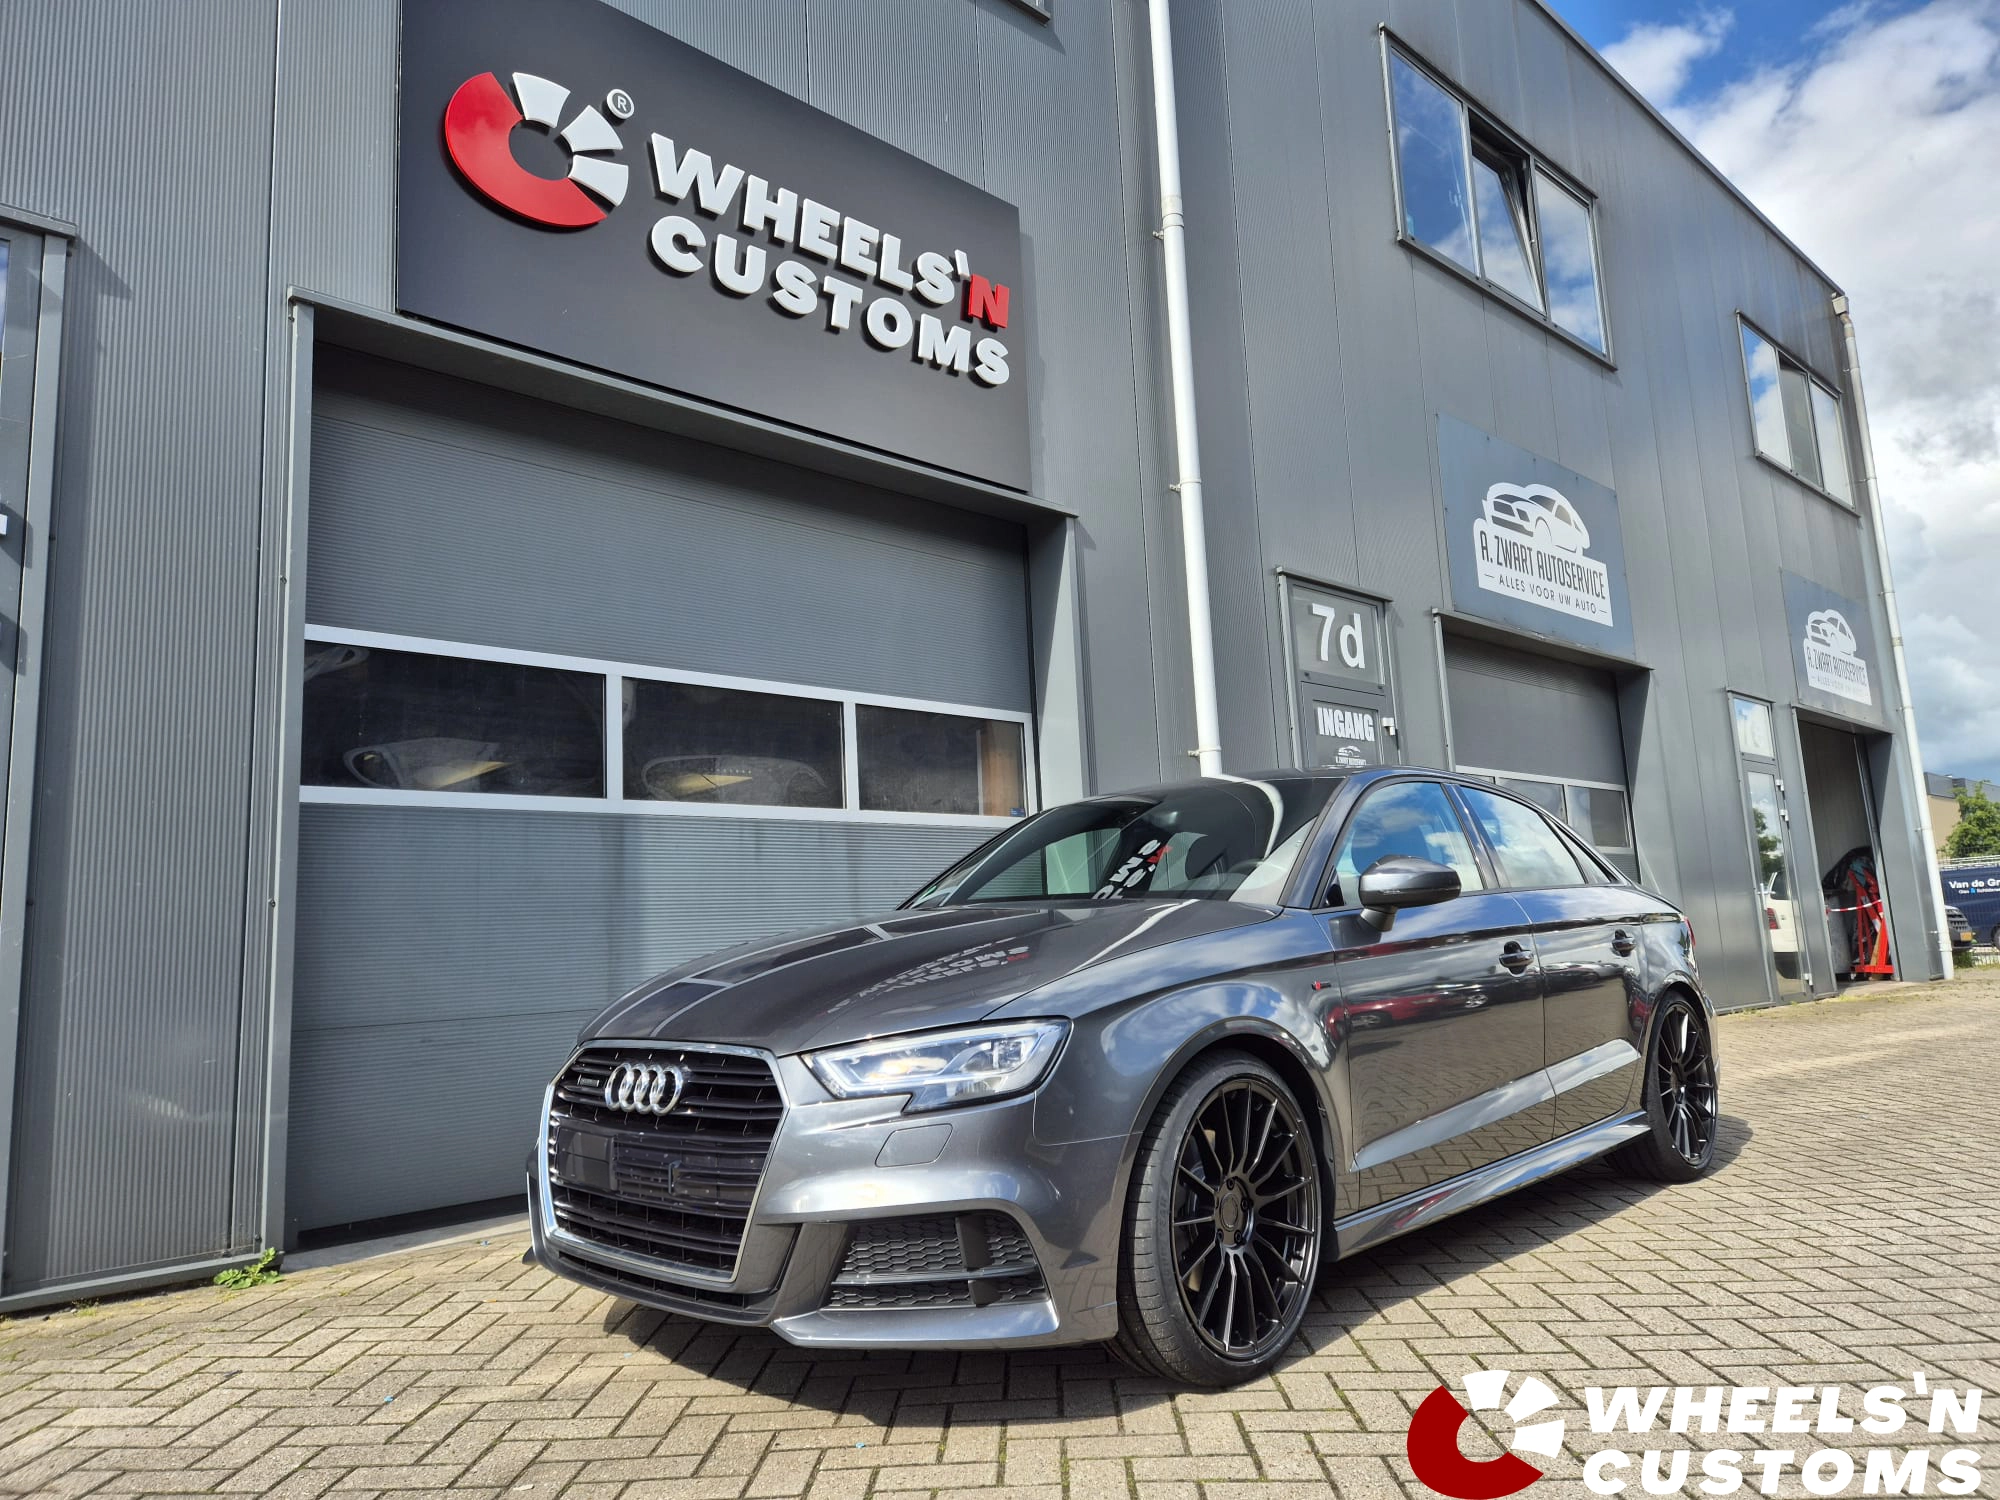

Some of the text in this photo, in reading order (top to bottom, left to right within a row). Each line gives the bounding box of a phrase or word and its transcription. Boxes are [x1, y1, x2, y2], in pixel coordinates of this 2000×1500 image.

[651, 132, 1010, 328] WHEELS'N
[651, 215, 1010, 385] CUSTOMS
[1480, 530, 1606, 600] A. ZWART AUTOSERVICE
[1499, 573, 1597, 614] ALLES VOOR UW AUTO
[1311, 603, 1366, 668] 7d
[1317, 707, 1375, 742] INGANG
